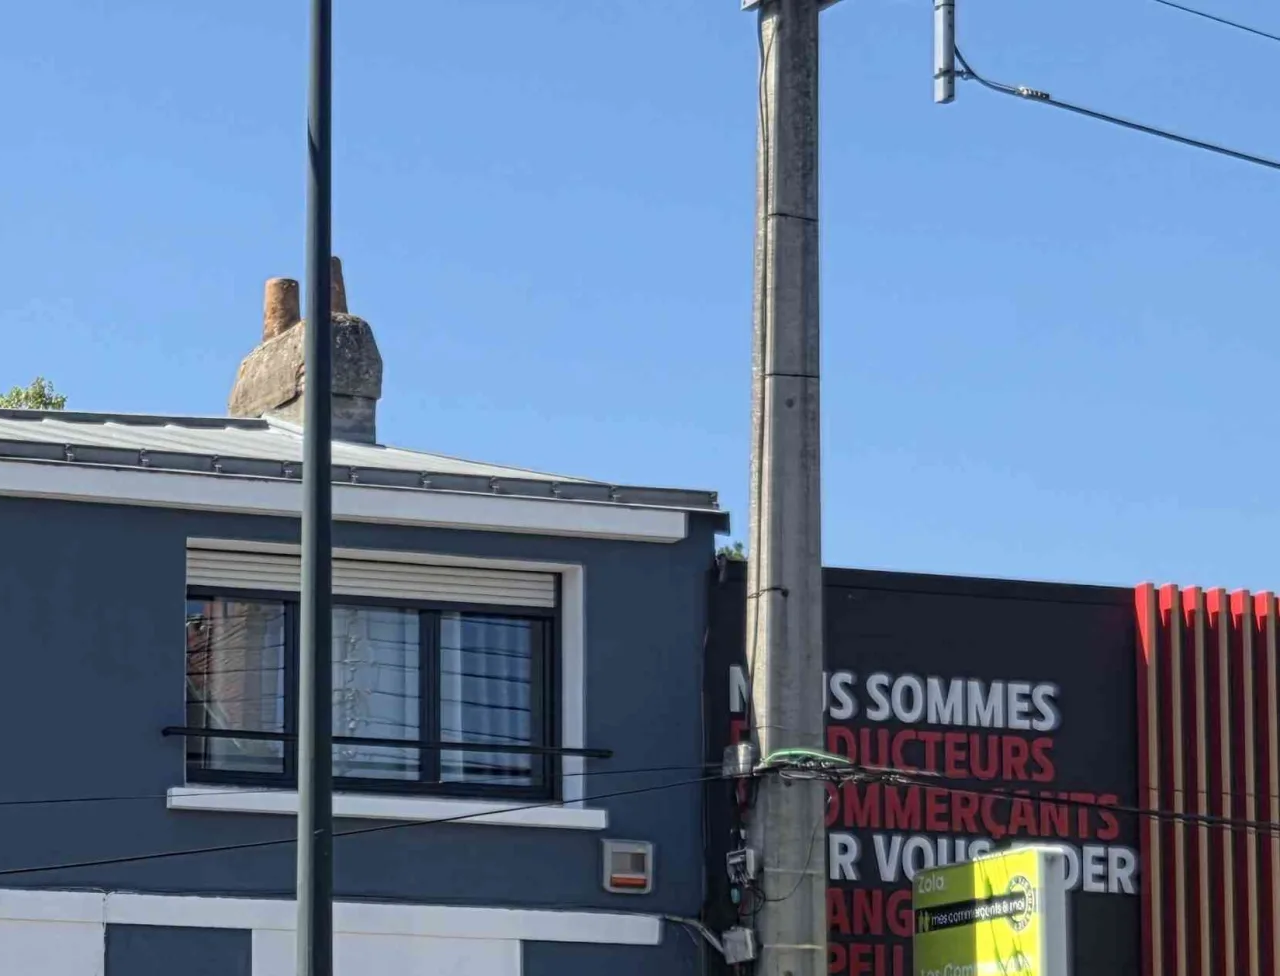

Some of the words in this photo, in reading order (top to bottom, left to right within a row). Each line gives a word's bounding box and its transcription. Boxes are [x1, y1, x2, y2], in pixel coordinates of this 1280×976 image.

[729, 664, 858, 721] NS
[866, 671, 1056, 732] SOMMES
[731, 720, 1055, 783] DUCTEURS
[824, 779, 1119, 841] OMMERÇANTS
[918, 872, 945, 894] Zola
